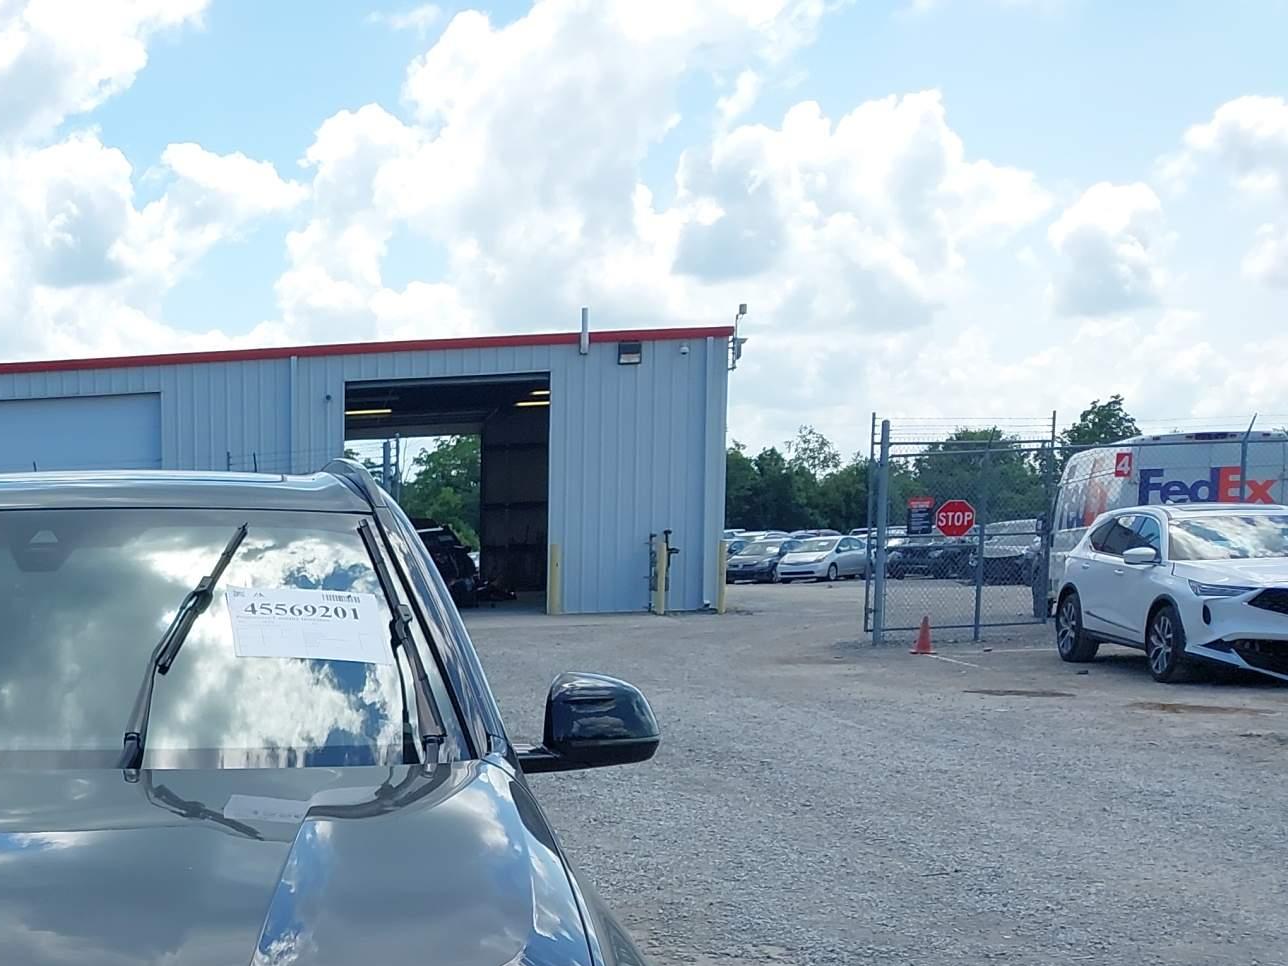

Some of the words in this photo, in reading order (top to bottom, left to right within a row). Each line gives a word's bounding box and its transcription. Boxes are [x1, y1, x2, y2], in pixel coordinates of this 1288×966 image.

[1116, 455, 1131, 475] 4
[1138, 466, 1278, 506] FedEx
[938, 511, 973, 527] STOP
[244, 602, 359, 620] 45569201
